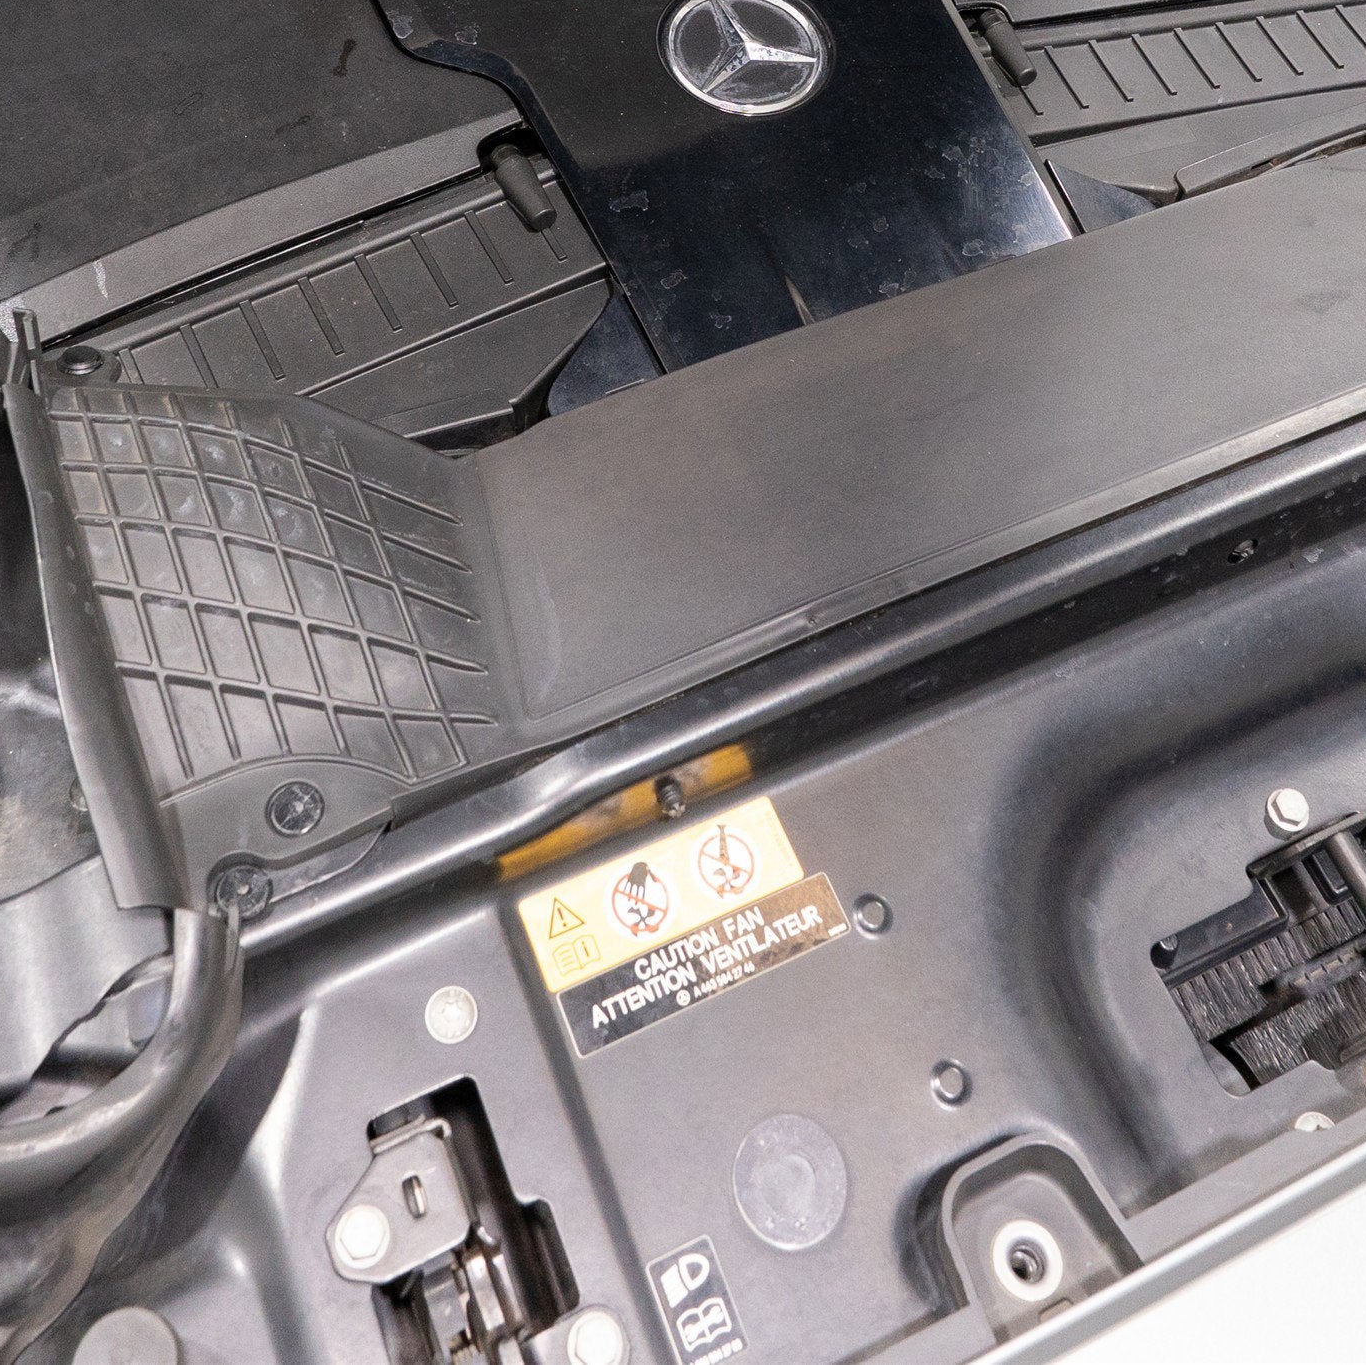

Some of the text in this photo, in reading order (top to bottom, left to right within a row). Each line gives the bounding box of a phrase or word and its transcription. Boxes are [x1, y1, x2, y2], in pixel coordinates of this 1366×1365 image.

[591, 905, 823, 1029] ATTENTION VENTILATEUR
[634, 906, 765, 981] CAUTION FAN
[692, 985, 702, 998] A
